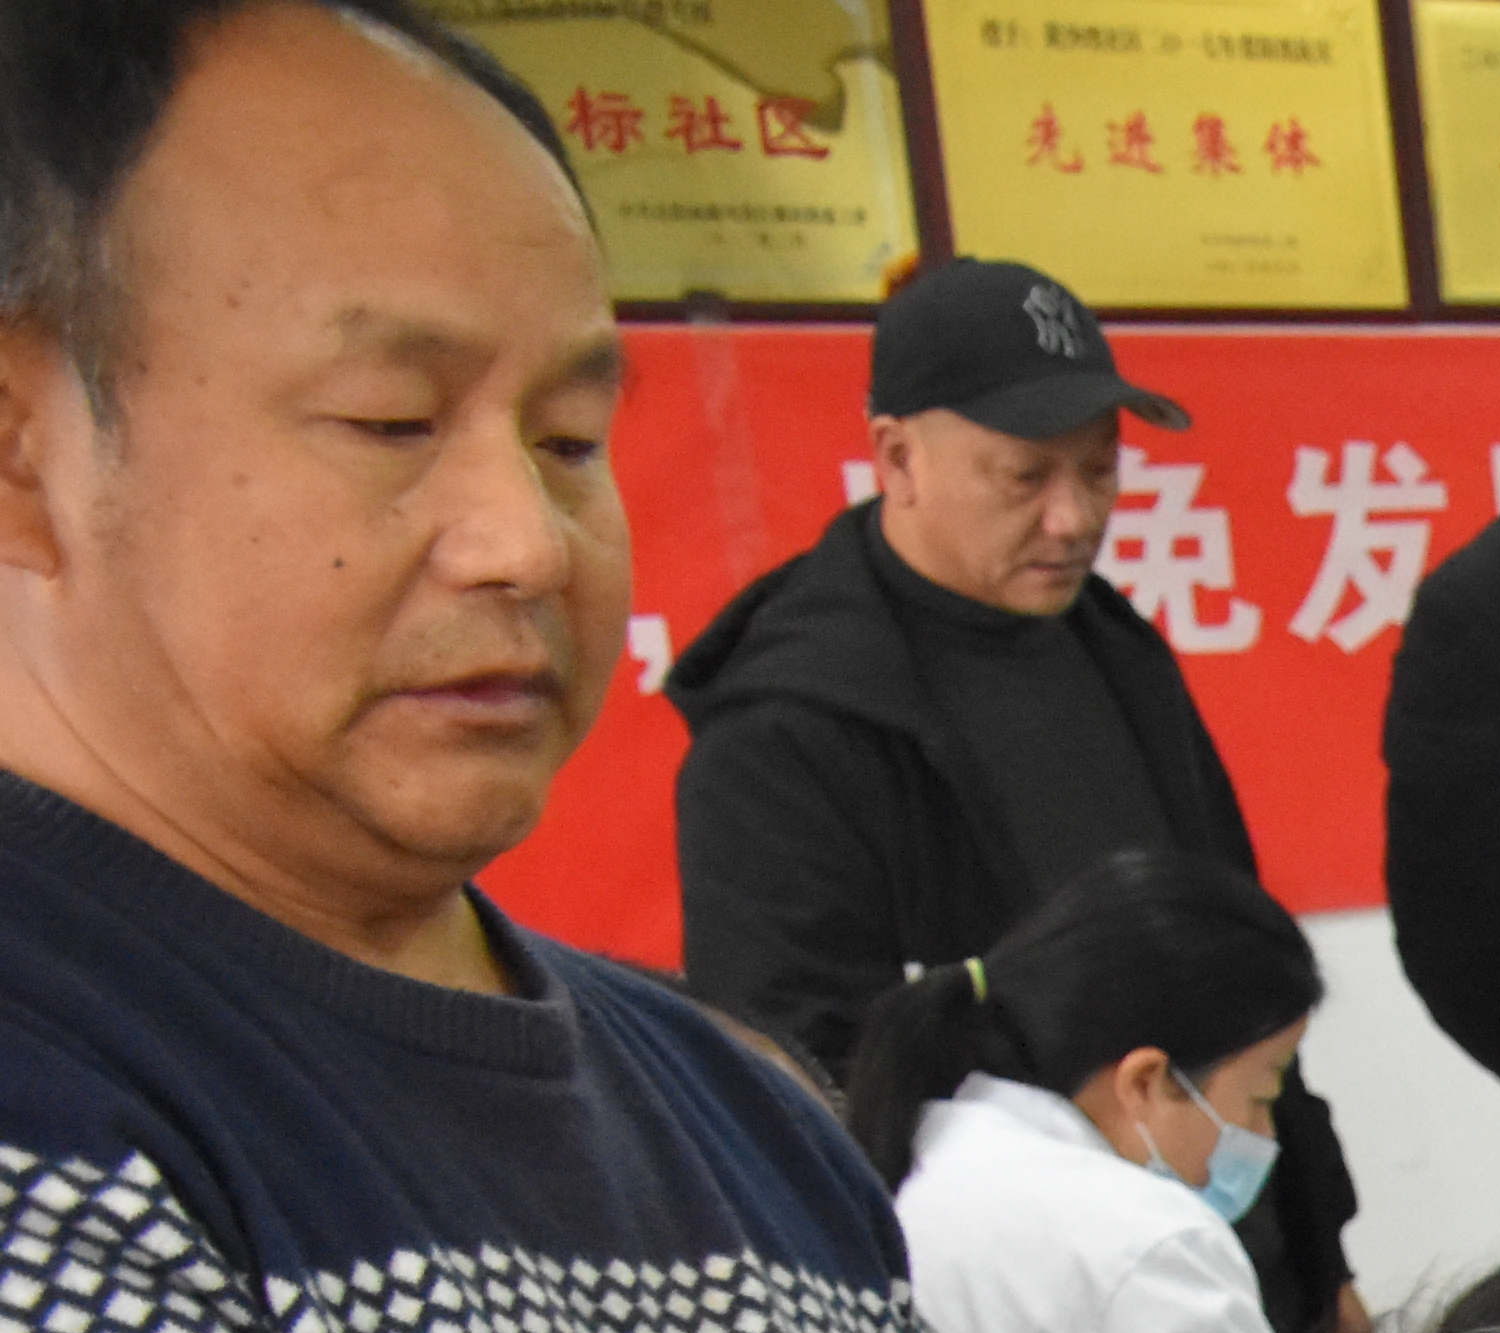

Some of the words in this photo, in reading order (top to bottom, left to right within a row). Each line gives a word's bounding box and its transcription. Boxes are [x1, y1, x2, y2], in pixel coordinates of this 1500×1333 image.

[564, 86, 832, 161] 标社区
[1026, 102, 1321, 176] 先进集体
